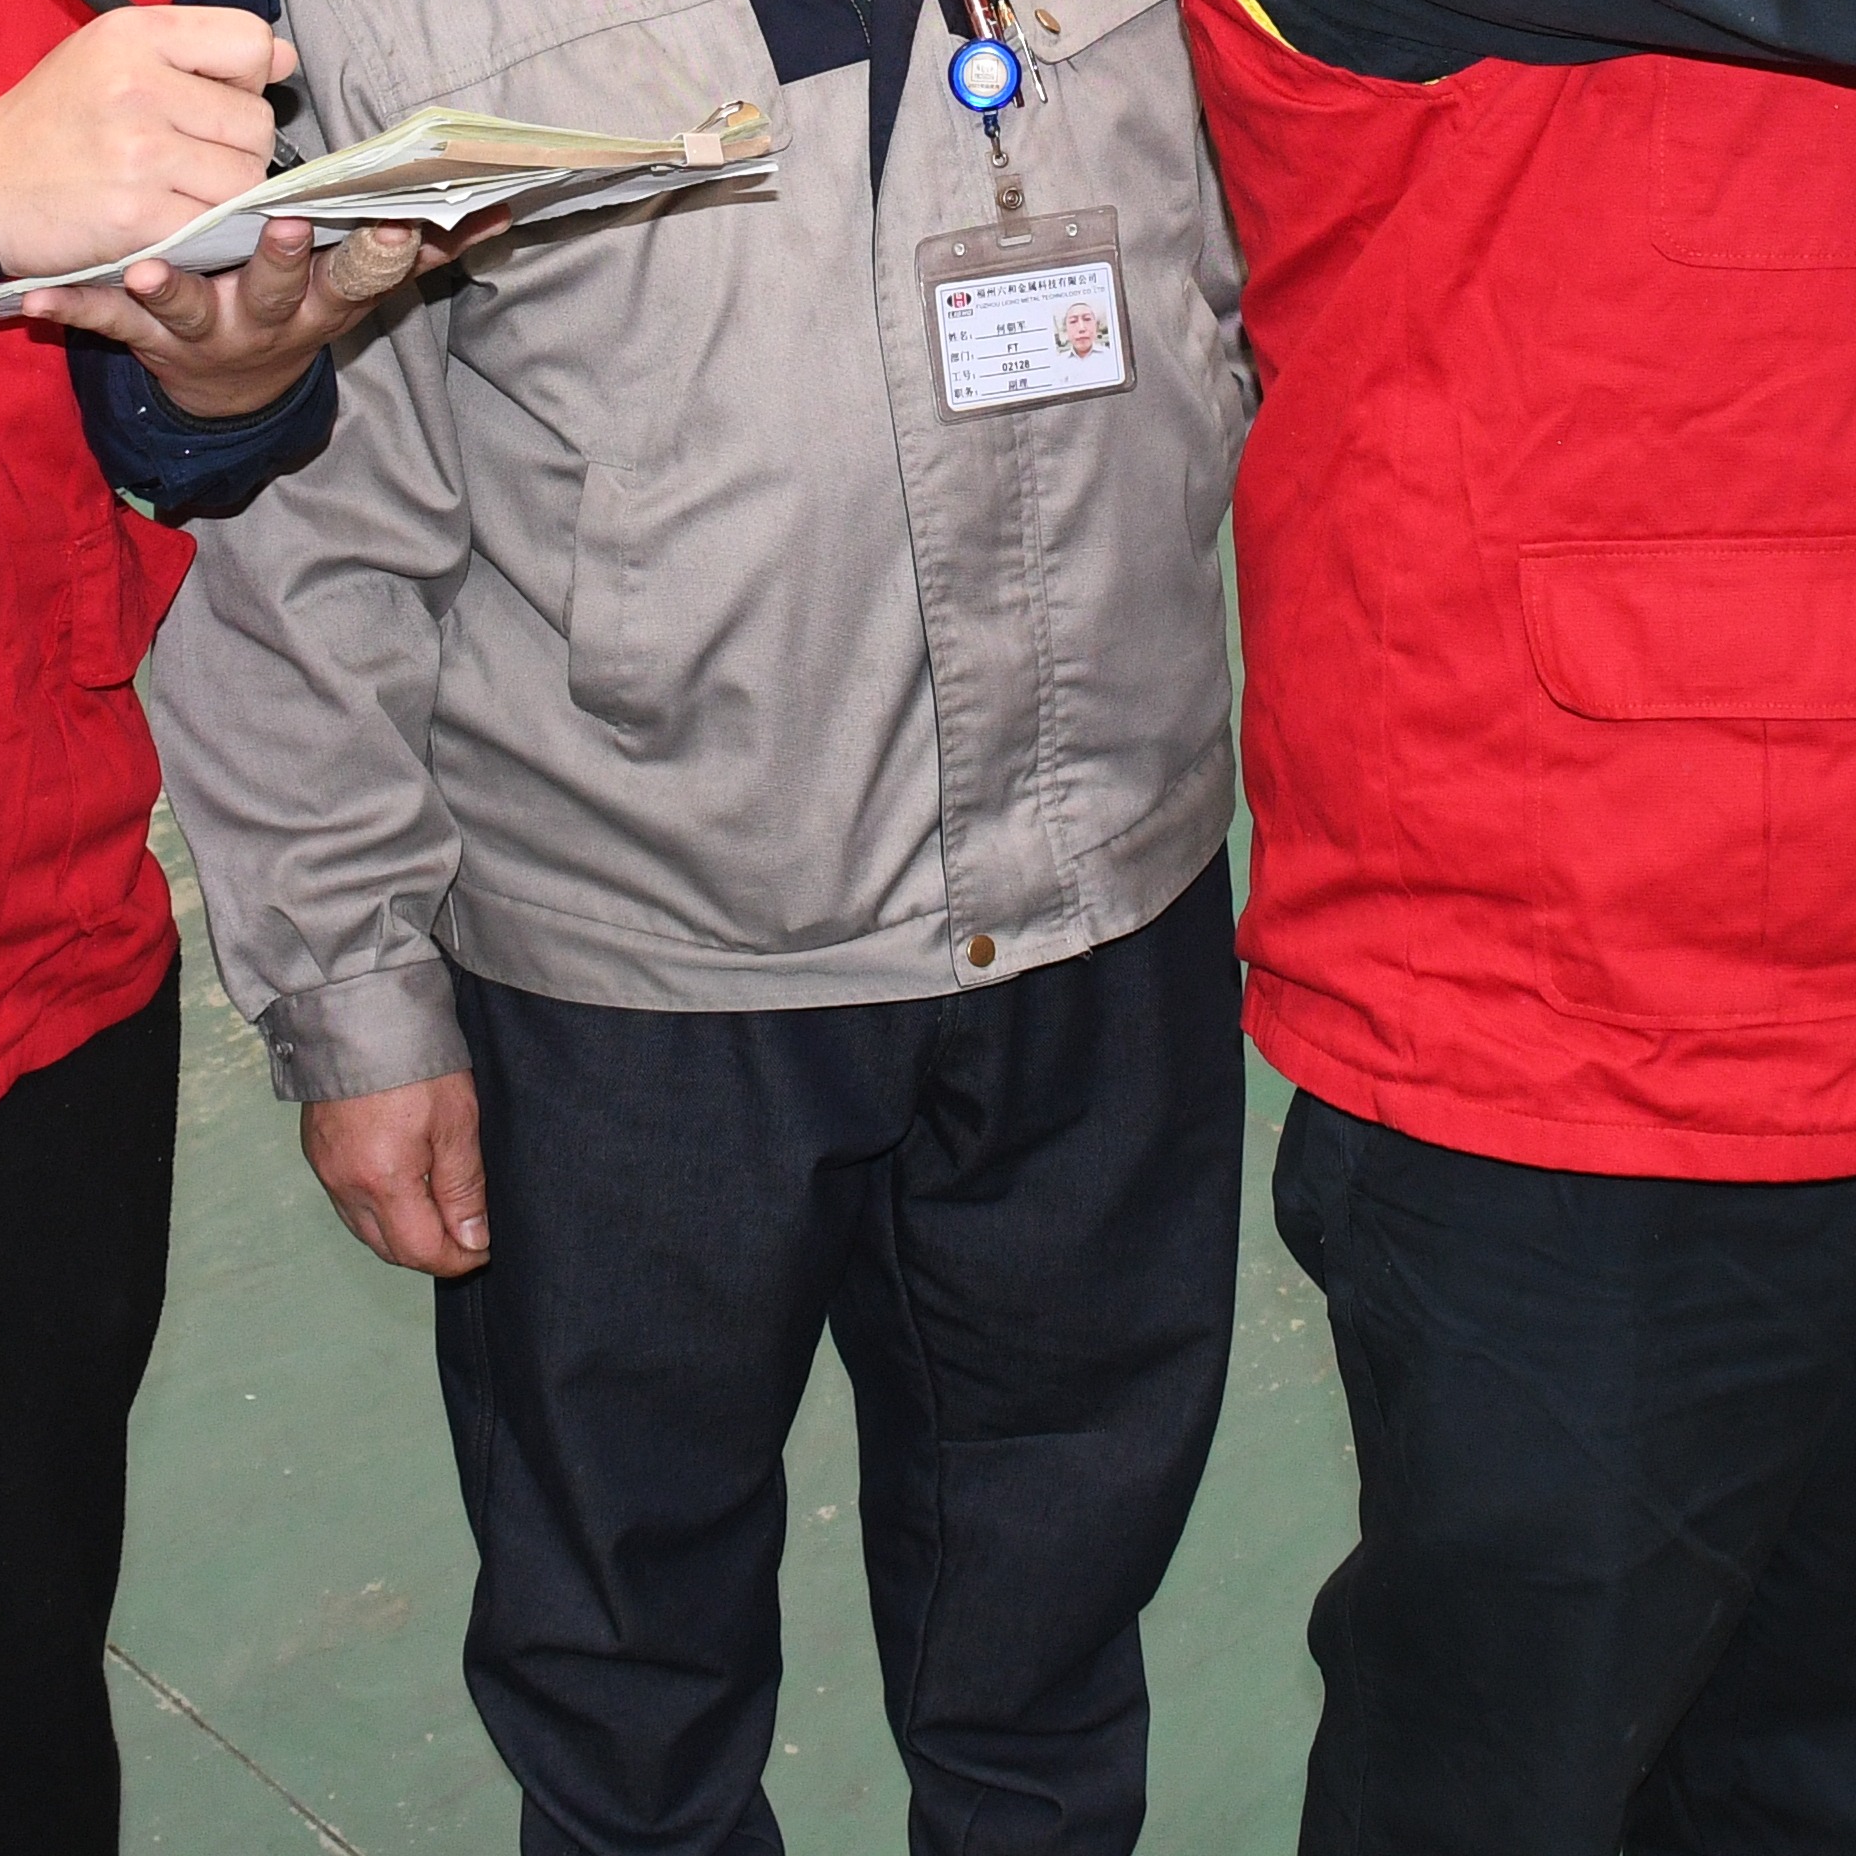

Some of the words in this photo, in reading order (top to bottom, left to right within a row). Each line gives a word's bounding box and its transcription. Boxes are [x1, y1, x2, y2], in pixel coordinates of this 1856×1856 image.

[976, 273, 1098, 299] 福州六和金属科技有限公司
[1001, 359, 1030, 372] 02128
